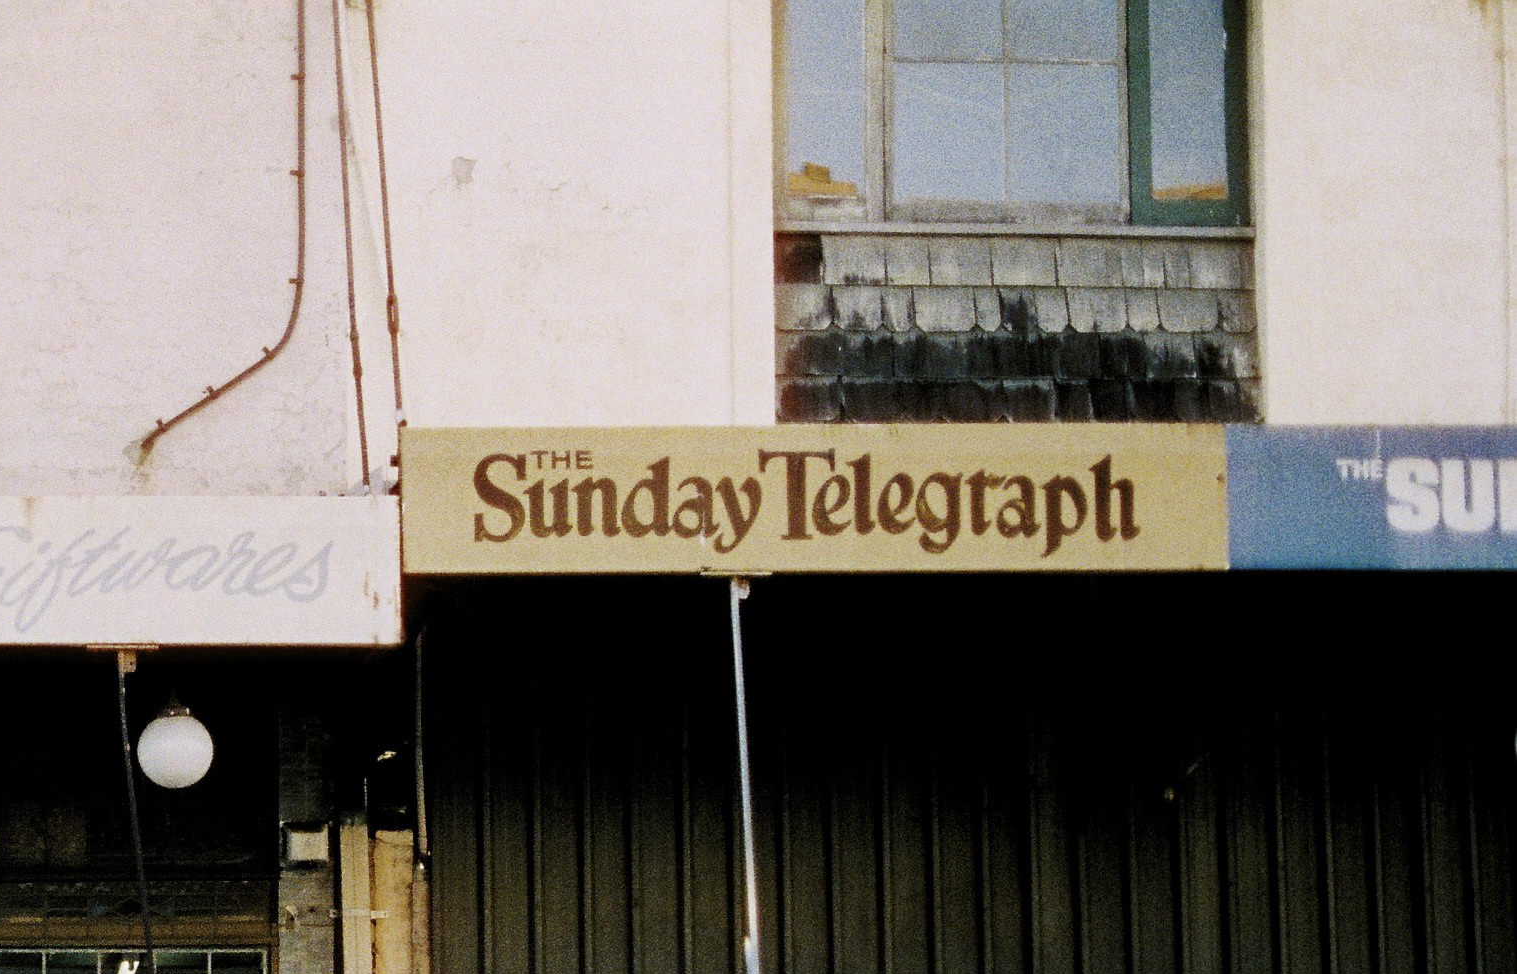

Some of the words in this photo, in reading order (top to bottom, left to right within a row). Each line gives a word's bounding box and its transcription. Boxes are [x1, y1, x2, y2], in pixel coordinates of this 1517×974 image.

[528, 450, 594, 471] THE
[1336, 458, 1383, 480] THE
[472, 452, 764, 554] Sunday
[758, 448, 1141, 558] Telegraph
